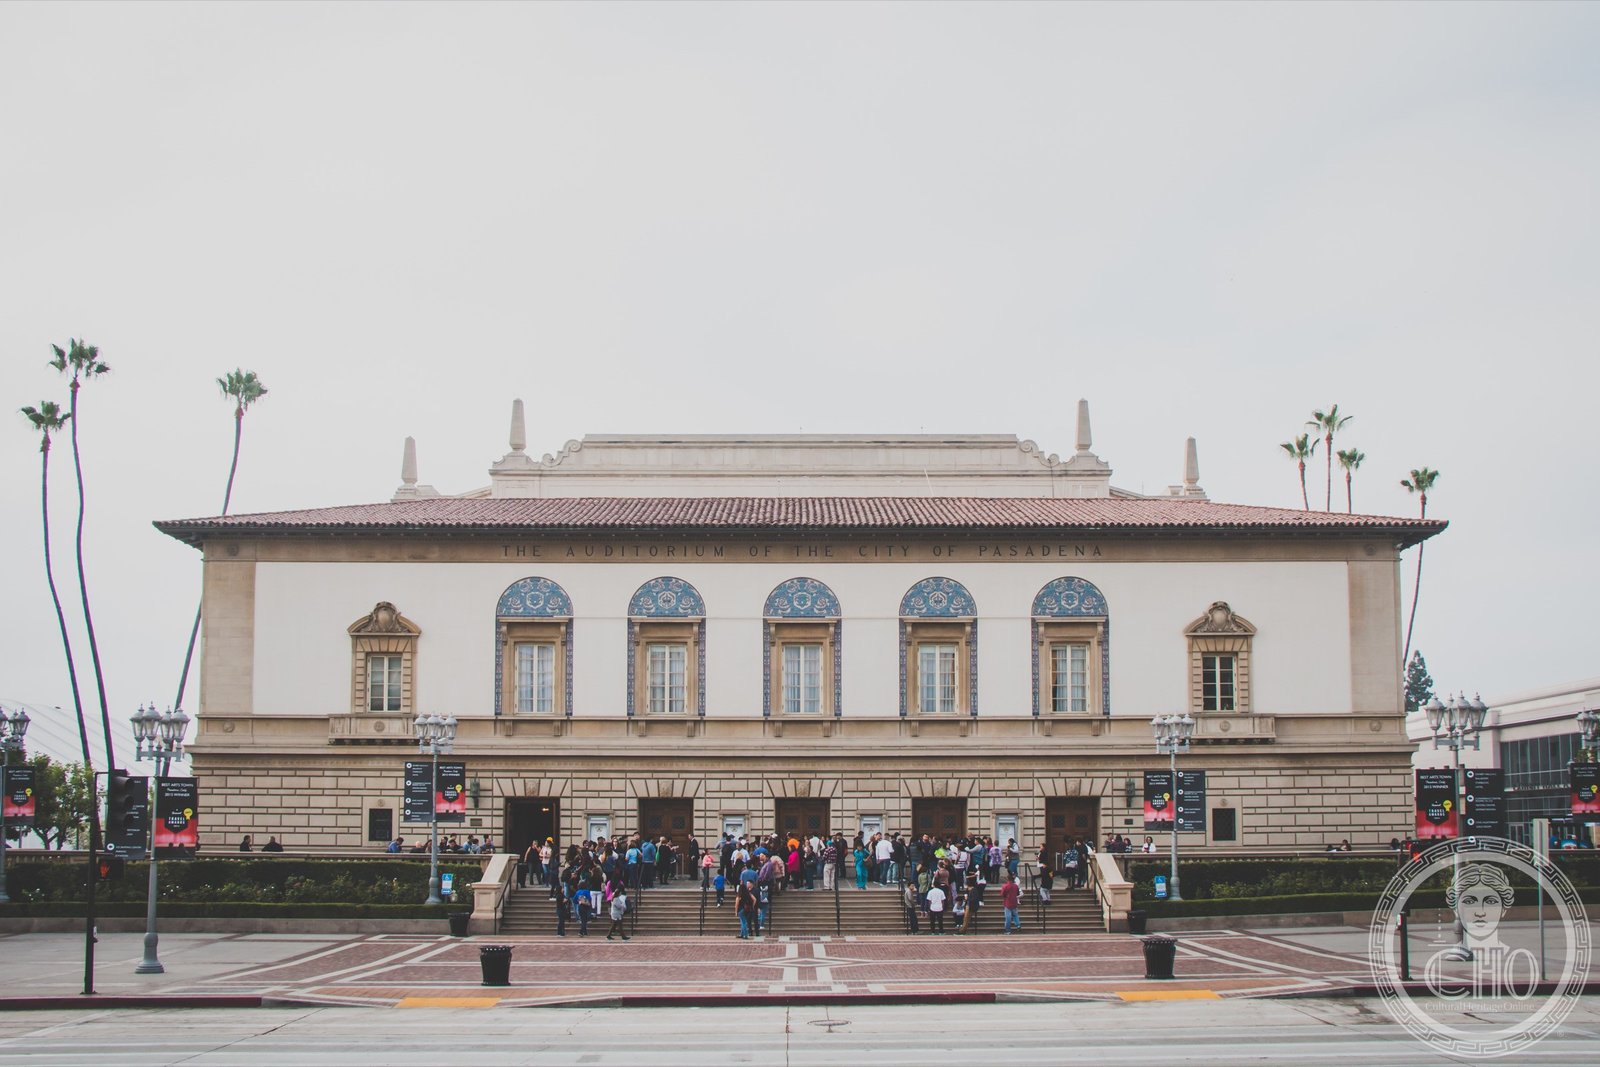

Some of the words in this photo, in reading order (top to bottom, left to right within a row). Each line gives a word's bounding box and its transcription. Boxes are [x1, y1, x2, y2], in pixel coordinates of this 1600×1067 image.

[503, 545, 541, 557] THE
[566, 545, 724, 557] AUDITORIUM
[749, 545, 772, 557] OF
[793, 545, 833, 557] THE
[858, 545, 911, 557] CITY
[932, 545, 955, 557] OF
[979, 545, 1102, 557] PASADENA
